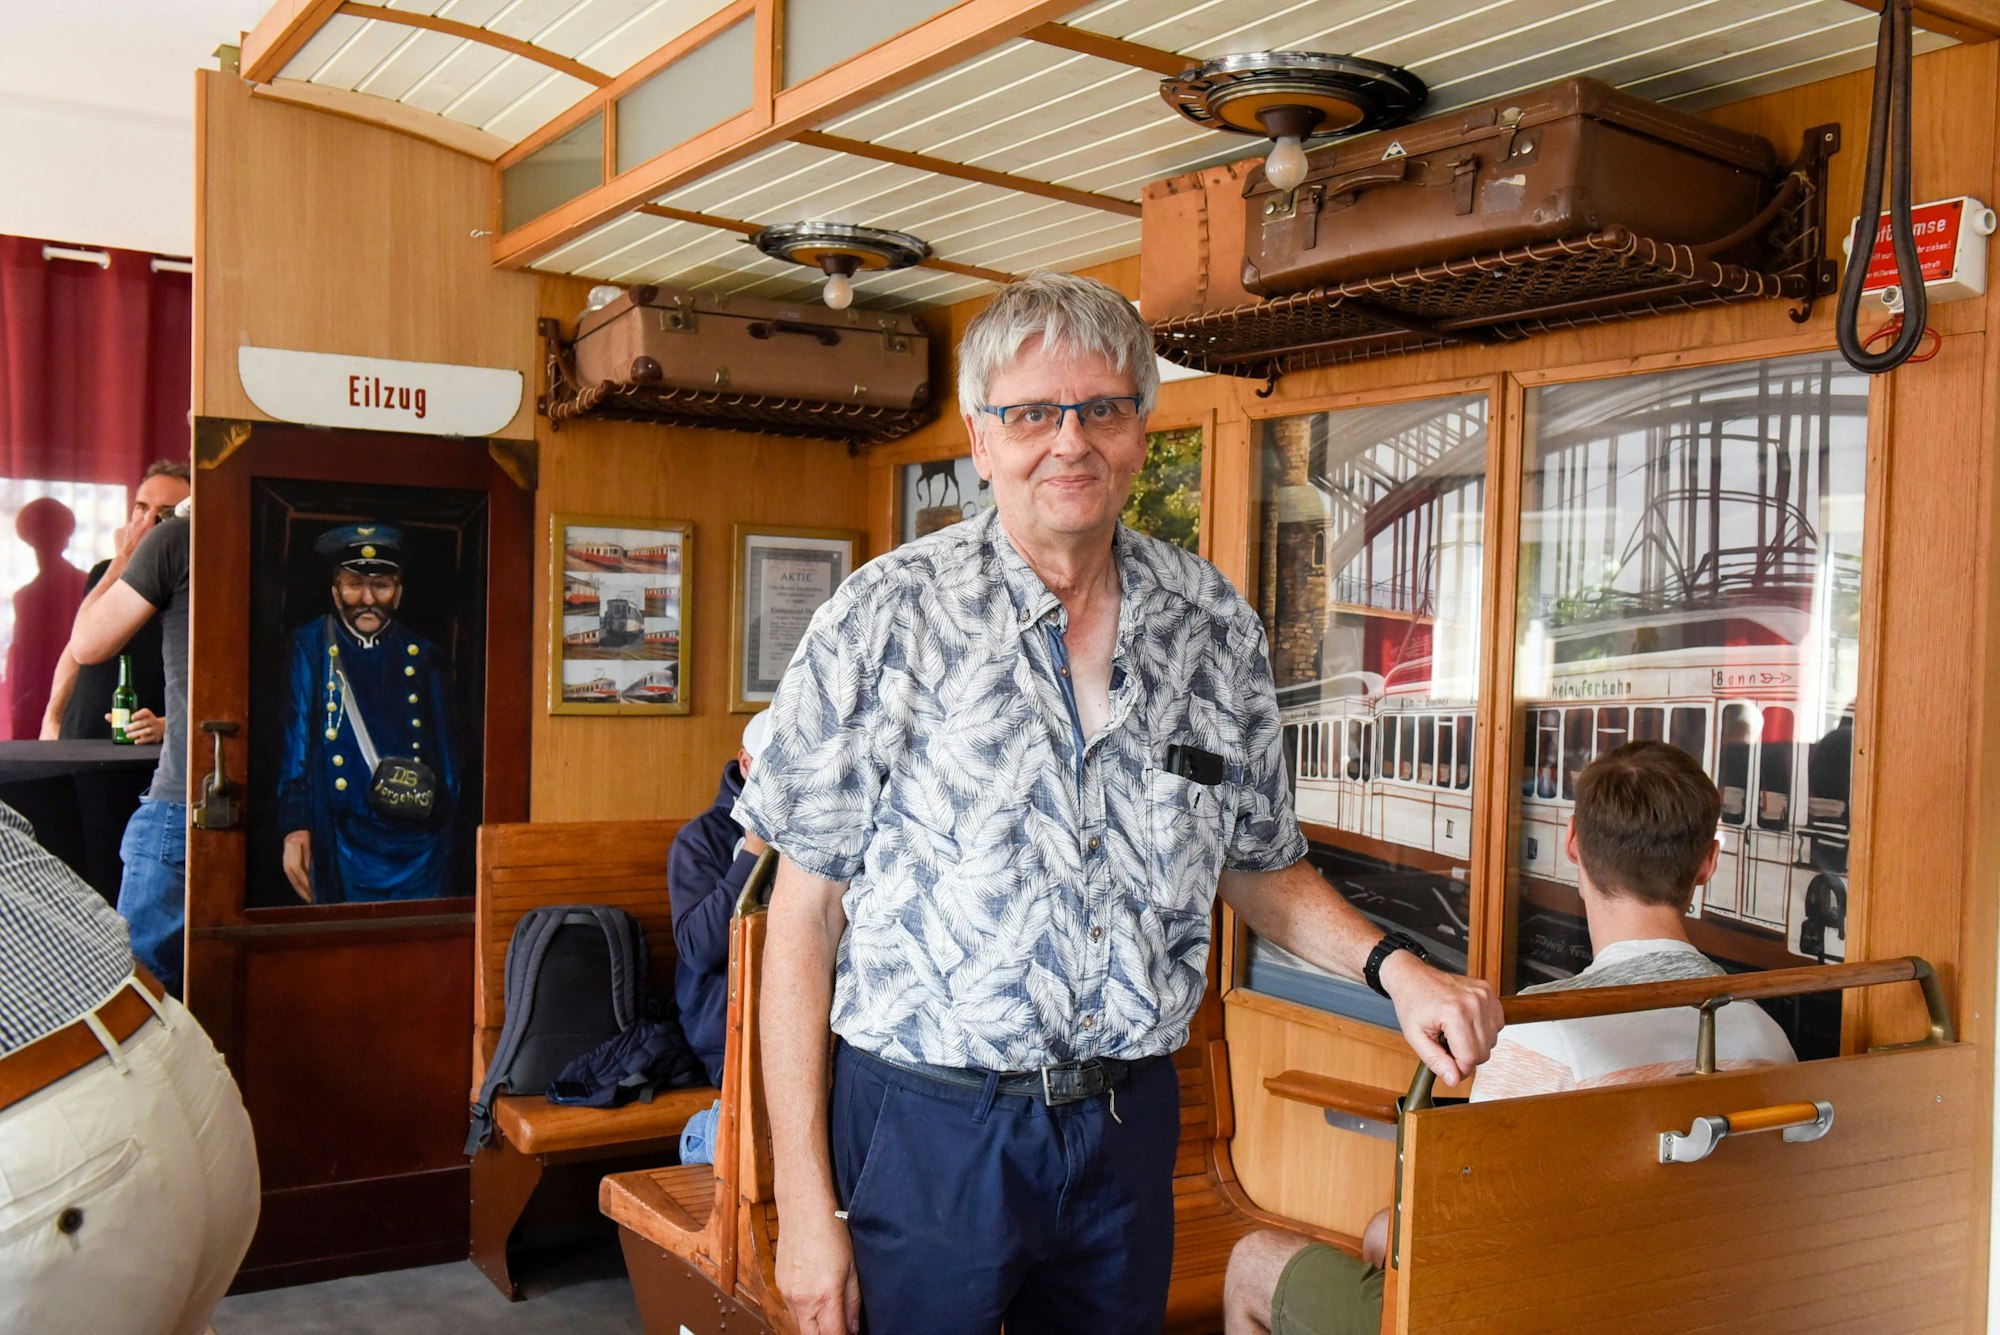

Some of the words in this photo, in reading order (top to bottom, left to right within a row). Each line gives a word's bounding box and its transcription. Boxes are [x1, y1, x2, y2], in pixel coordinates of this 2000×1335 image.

[349, 375, 427, 418] Eilzug
[781, 572, 813, 583] AKTIE
[1716, 671, 1756, 686] Bonn
